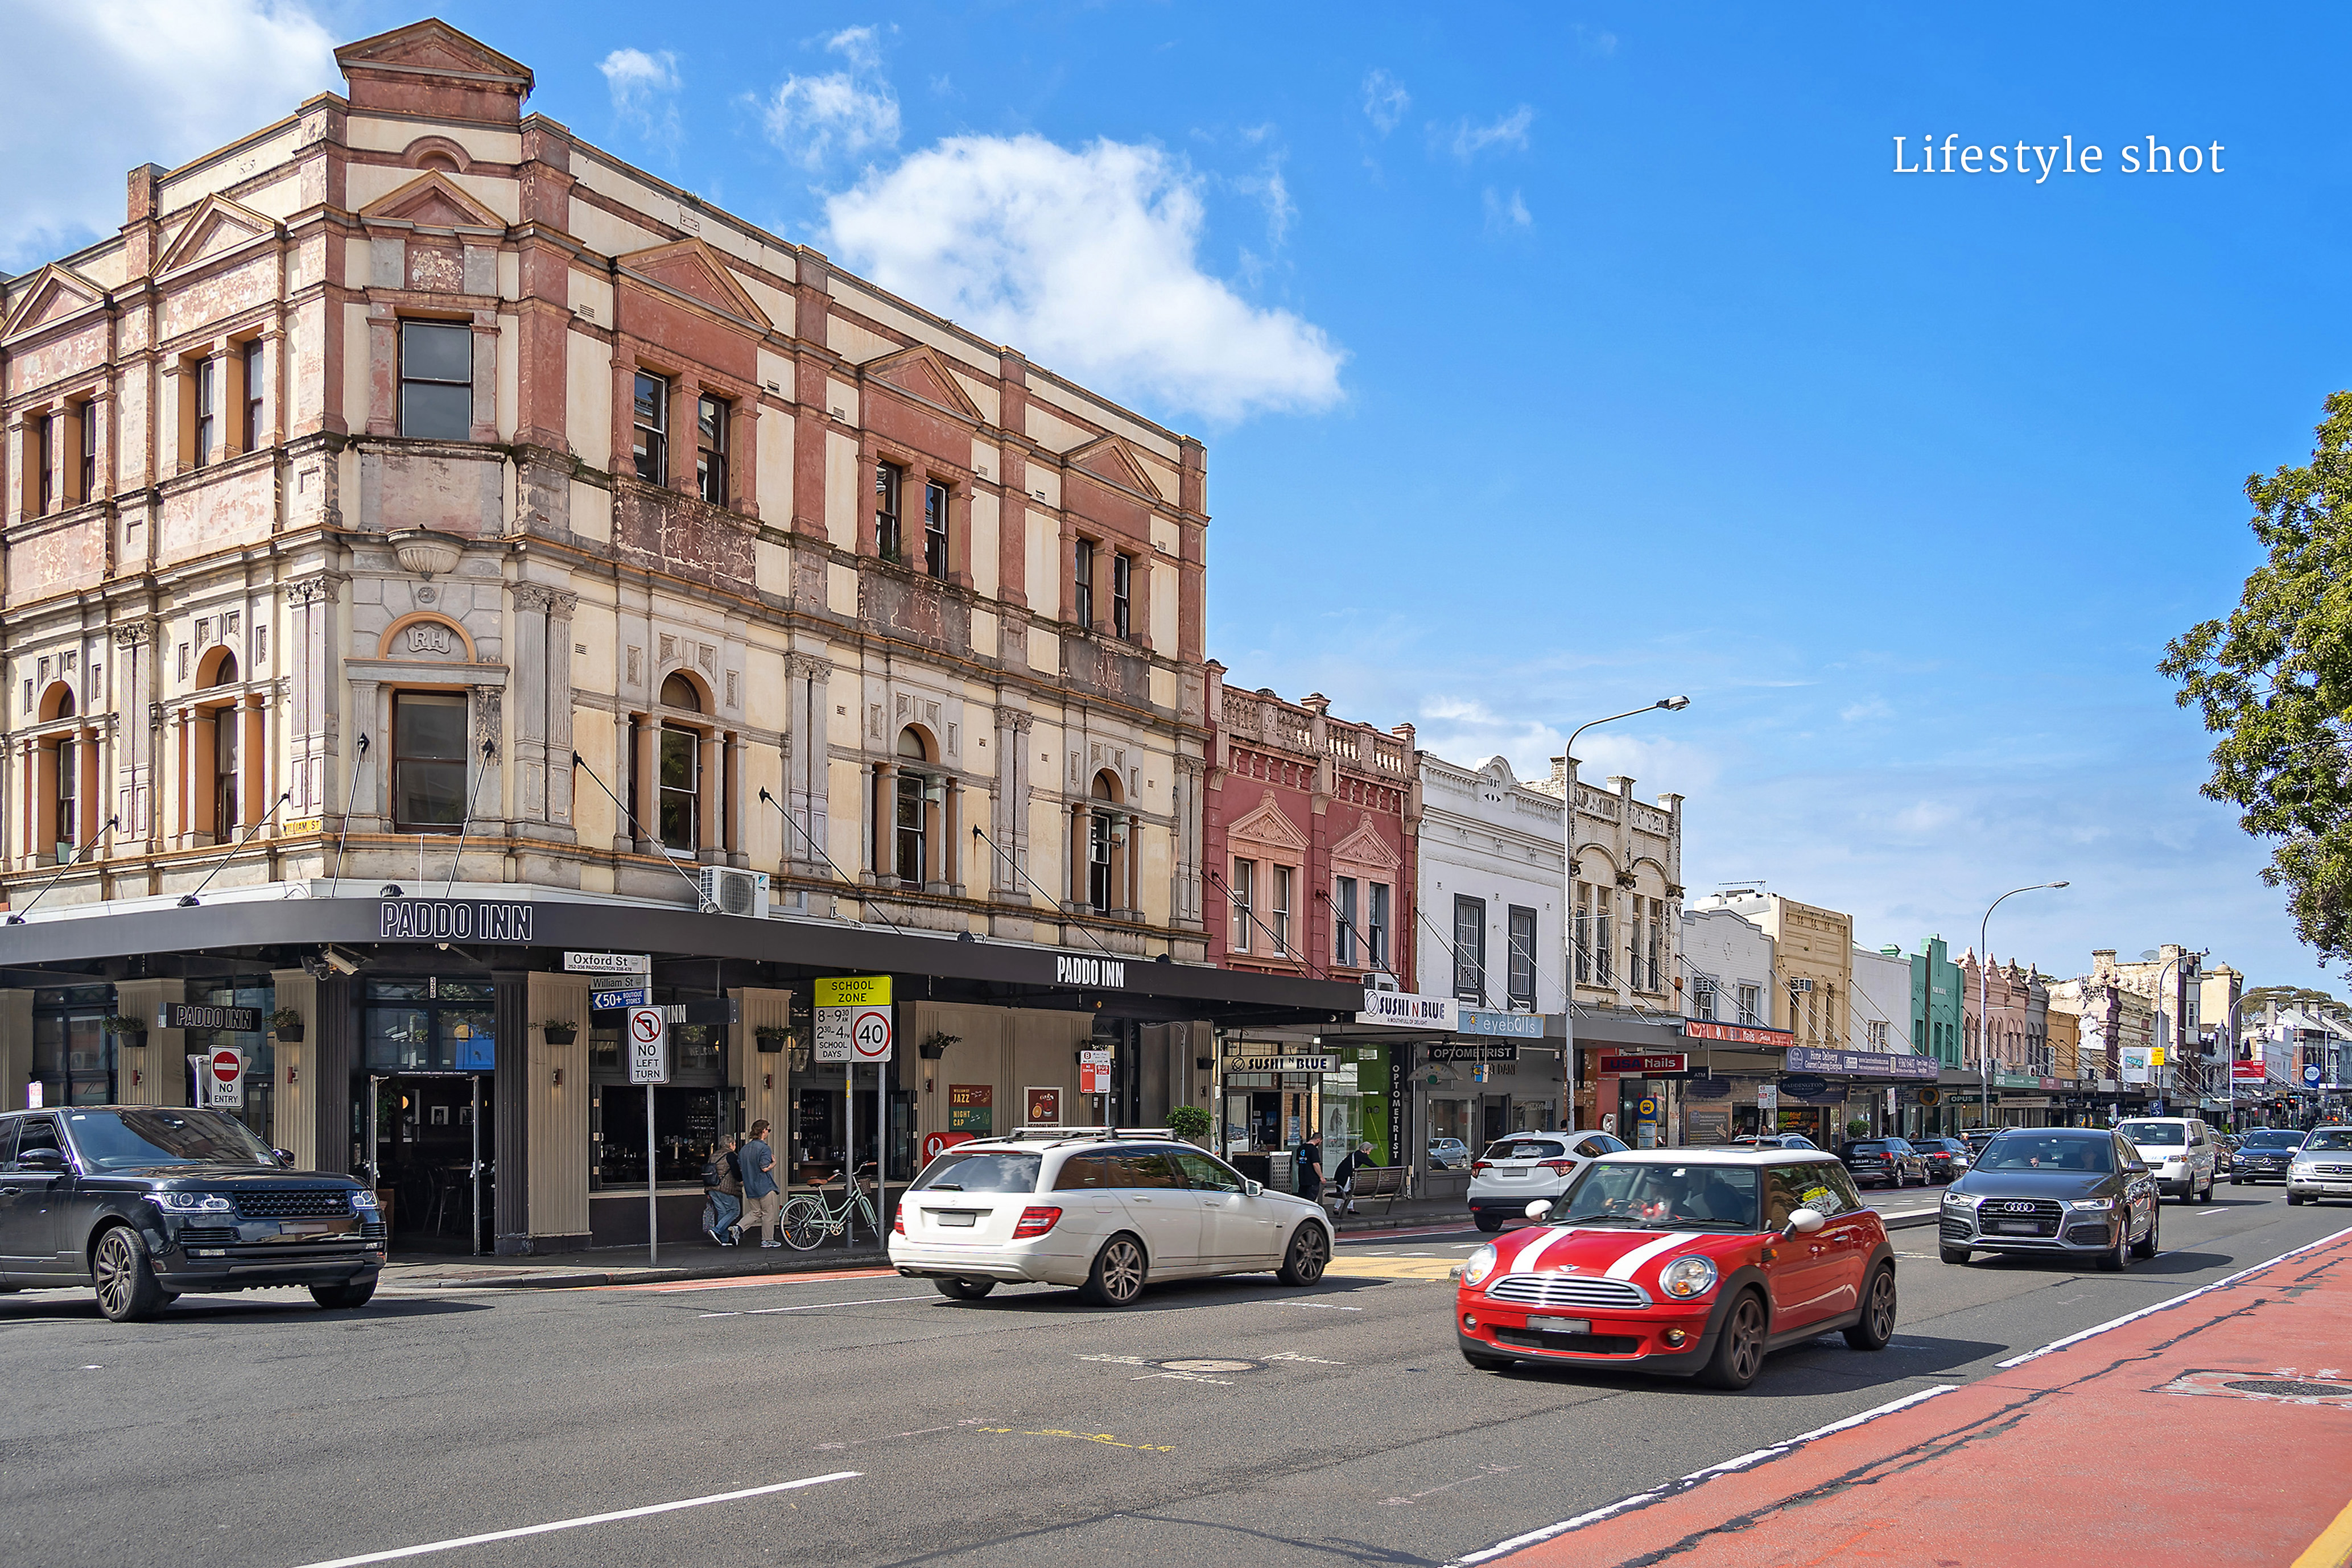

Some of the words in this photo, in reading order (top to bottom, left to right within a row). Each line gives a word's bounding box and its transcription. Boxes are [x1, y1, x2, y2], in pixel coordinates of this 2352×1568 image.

[1487, 778, 1500, 789] 1887
[380, 902, 472, 939] PADDO
[479, 904, 533, 940] INN
[573, 954, 612, 965] Oxford
[616, 956, 628, 966] St
[1057, 955, 1099, 986] PADDO
[1101, 960, 1125, 988] INN
[593, 977, 622, 988] William
[625, 977, 634, 987] St
[831, 981, 874, 991] SCHOOL
[603, 993, 622, 1007] 50+
[838, 993, 866, 1002] ZONE
[1379, 996, 1409, 1017] SUSHI
[1412, 1002, 1419, 1017] N
[1422, 1001, 1445, 1020] BLUE
[176, 1006, 222, 1028] PADDO
[225, 1009, 251, 1029] INN
[667, 1004, 686, 1024] INN
[1483, 1016, 1536, 1034] eyeballs
[859, 1024, 883, 1044] 40
[638, 1045, 656, 1056] NO
[1434, 1048, 1512, 1058] OPTOMETRIST
[636, 1059, 659, 1067] LEFT
[1248, 1058, 1284, 1070] SUSHI
[1296, 1058, 1327, 1070] BLUE
[1611, 1059, 1641, 1068] USA
[1645, 1058, 1676, 1068] Nails
[2127, 1057, 2142, 1066] SOLD
[635, 1070, 660, 1078] TURN
[219, 1084, 233, 1092] NO
[953, 1094, 970, 1103] JAZZ
